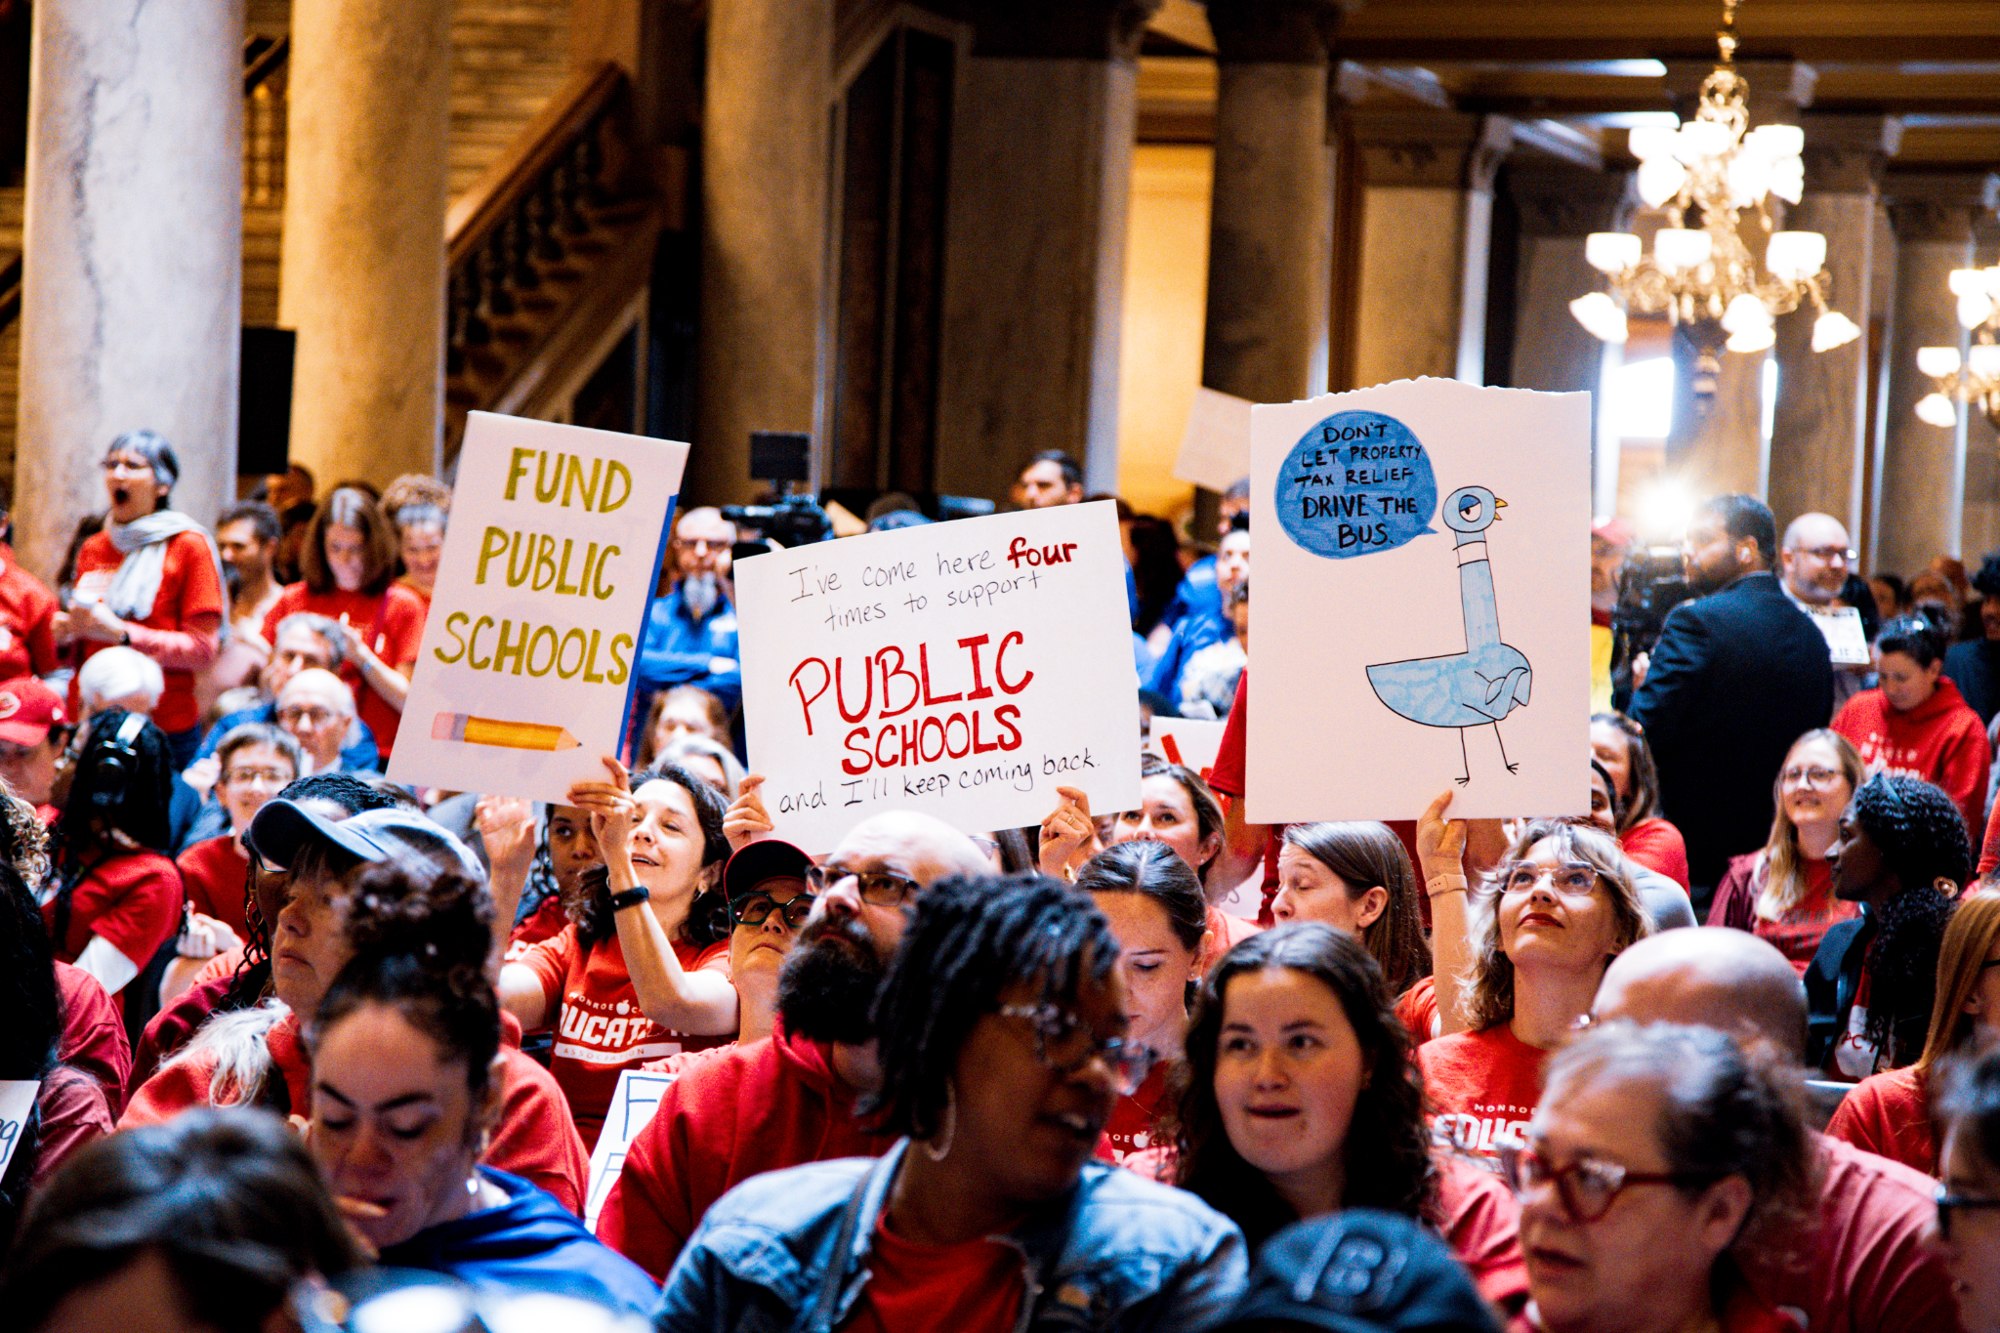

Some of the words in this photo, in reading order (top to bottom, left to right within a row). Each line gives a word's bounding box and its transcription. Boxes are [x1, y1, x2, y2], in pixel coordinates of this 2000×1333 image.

[1301, 449, 1340, 468] LET
[1350, 444, 1423, 463] PROPERTY
[1323, 421, 1387, 443] DON'T
[504, 447, 632, 513] FUND
[1294, 471, 1334, 487] TAX
[1345, 467, 1414, 485] RELIEF
[1302, 494, 1369, 519] DRIVE
[1377, 496, 1418, 516] THE
[475, 526, 621, 600] PUBLIC
[788, 565, 842, 602] I've
[862, 559, 917, 588] come
[936, 549, 997, 576] here
[1007, 536, 1078, 571] four
[1338, 523, 1394, 549] BUS.
[825, 599, 887, 632] times
[904, 592, 928, 613] to
[947, 570, 1044, 610] support
[434, 611, 634, 685] SCHOOLS
[788, 630, 1035, 736] PUBLIC
[841, 704, 1023, 775] SCHOOLS
[779, 786, 827, 814] and
[841, 775, 888, 808] I'll
[903, 773, 951, 799] keep
[959, 760, 1034, 791] coming
[1043, 747, 1101, 773] back.
